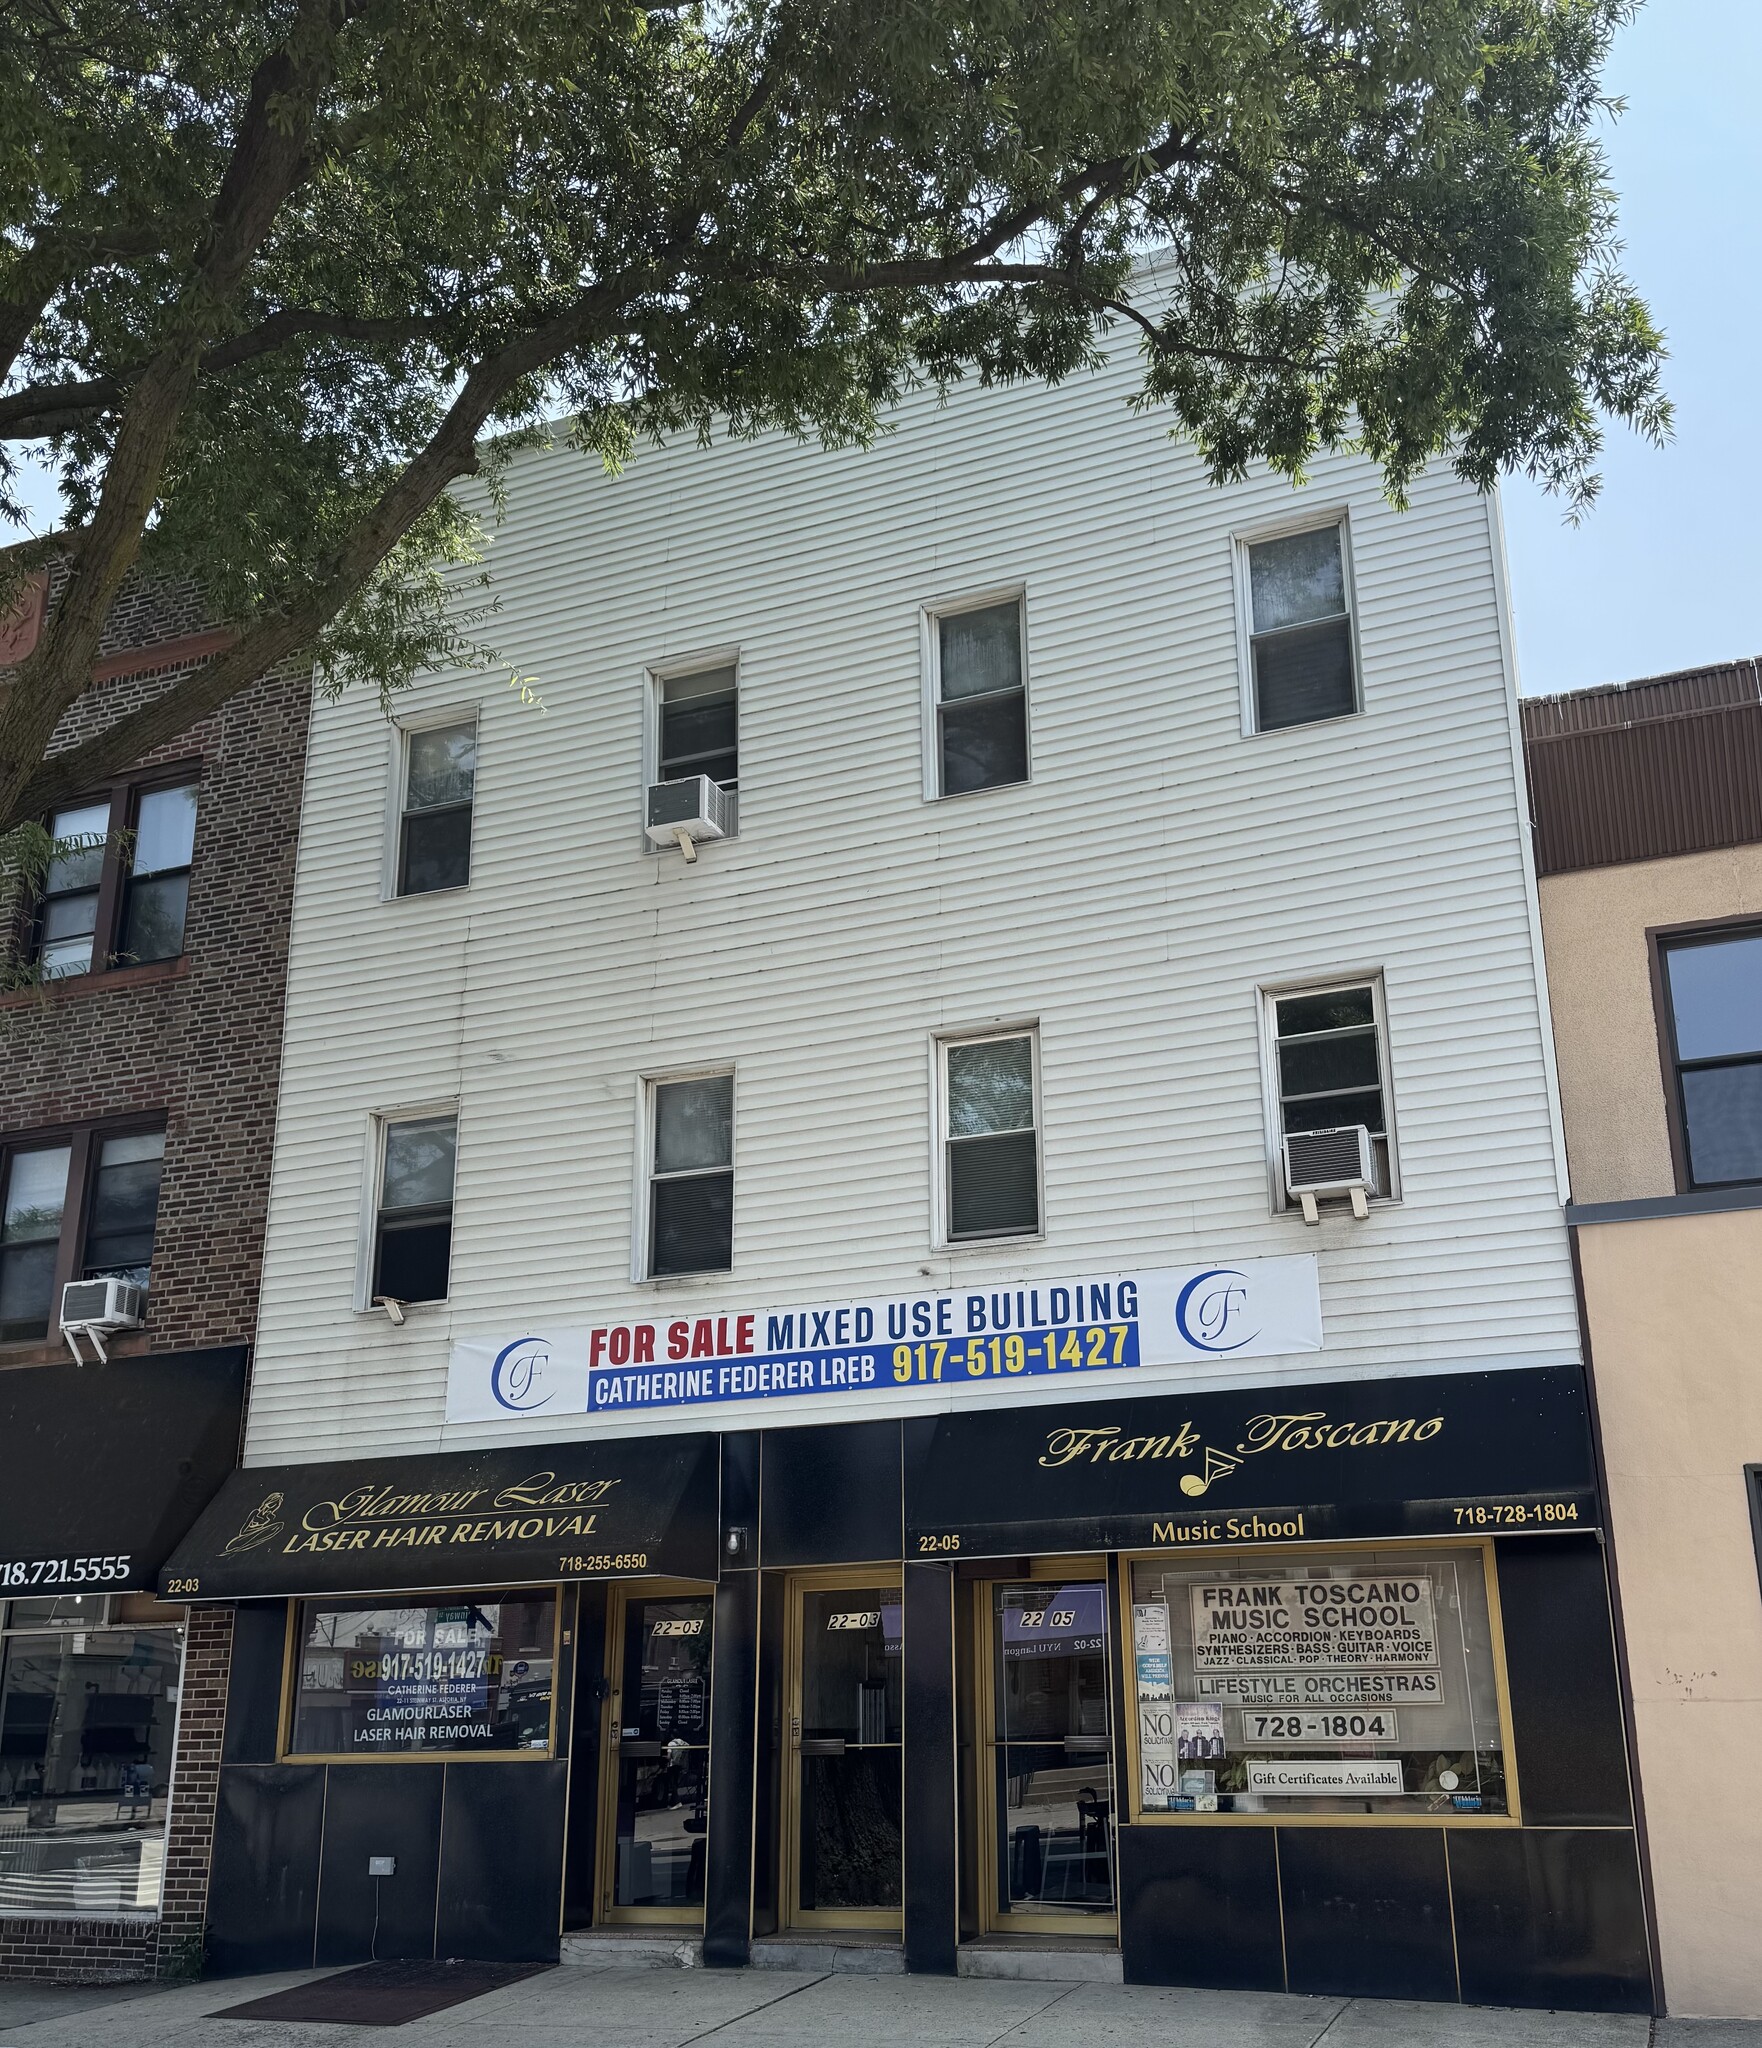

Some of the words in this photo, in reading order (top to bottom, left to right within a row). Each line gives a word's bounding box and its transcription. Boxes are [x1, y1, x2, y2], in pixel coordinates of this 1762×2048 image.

[589, 1324, 656, 1368] FOR
[667, 1314, 755, 1361] SALE
[767, 1306, 874, 1352] MIXED
[888, 1298, 953, 1340] USE
[967, 1280, 1139, 1333] BUILDING
[595, 1368, 713, 1405] CATHERINE
[719, 1360, 814, 1395] FEDERER
[820, 1354, 876, 1386] LREB
[892, 1325, 1129, 1383] 917-519-1427
[1038, 1420, 1201, 1468] Frank
[1236, 1411, 1445, 1455] Toscano
[302, 1484, 489, 1532] Glamour
[493, 1471, 622, 1507] Laser
[1453, 1502, 1580, 1527] 718-728-1804
[284, 1530, 373, 1554] LASER
[372, 1525, 448, 1548] HAIR
[449, 1514, 598, 1543] REMOVAL
[1152, 1520, 1223, 1544] Music
[1226, 1513, 1305, 1541] School
[919, 1534, 961, 1553] 22-05
[0, 1555, 131, 1586] 18.721.5555
[559, 1553, 648, 1572] 718-255-6550
[167, 1578, 200, 1593] 22-03
[1203, 1586, 1283, 1608] FRANK
[1294, 1582, 1420, 1605] TOSCANO
[828, 1613, 880, 1629] 22-03
[1021, 1612, 1044, 1627] 22
[1050, 1611, 1074, 1626] 05
[1212, 1608, 1290, 1630] MUSIC
[1304, 1605, 1416, 1628] SCHOOL
[394, 1629, 427, 1646] FOR
[434, 1627, 480, 1645] SALE
[652, 1620, 703, 1636] 22-03
[1209, 1633, 1248, 1644] PIANO
[1256, 1631, 1331, 1643] ACCORDION
[1339, 1629, 1421, 1641] KEYBOARDS
[1197, 1643, 1290, 1656] SYNTHESIZERS
[1296, 1642, 1331, 1654] BASS
[1337, 1641, 1384, 1653] GUITAR
[1392, 1641, 1433, 1652] VOICE
[381, 1650, 486, 1682] 917-519-1427
[1203, 1657, 1230, 1666] JAZZ
[1236, 1655, 1294, 1665] CLASSICAL
[1299, 1655, 1320, 1664] POP
[1326, 1654, 1369, 1663] THEORY
[1375, 1653, 1430, 1662] HARMONY
[387, 1685, 437, 1695] CATHERINE
[439, 1683, 476, 1694] FEDERER
[1199, 1678, 1296, 1695] LIFESTYLE
[1304, 1675, 1437, 1693] ORCHESTRAS
[1242, 1694, 1273, 1703] MUSIC
[1279, 1694, 1300, 1703] FOR
[1304, 1694, 1325, 1702] ALL
[1330, 1693, 1393, 1702] OCCASIONS
[366, 1705, 472, 1721] GLAMOURLASER
[354, 1726, 391, 1742] LASER
[394, 1725, 426, 1740] HAIR
[429, 1723, 494, 1739] REMOVAL
[1143, 1713, 1173, 1737] NO
[1254, 1715, 1386, 1738] 728-1804
[1145, 1764, 1175, 1787] NO
[1253, 1772, 1276, 1785] Gift
[1278, 1772, 1343, 1785] Certificates
[1345, 1772, 1398, 1785] Available
